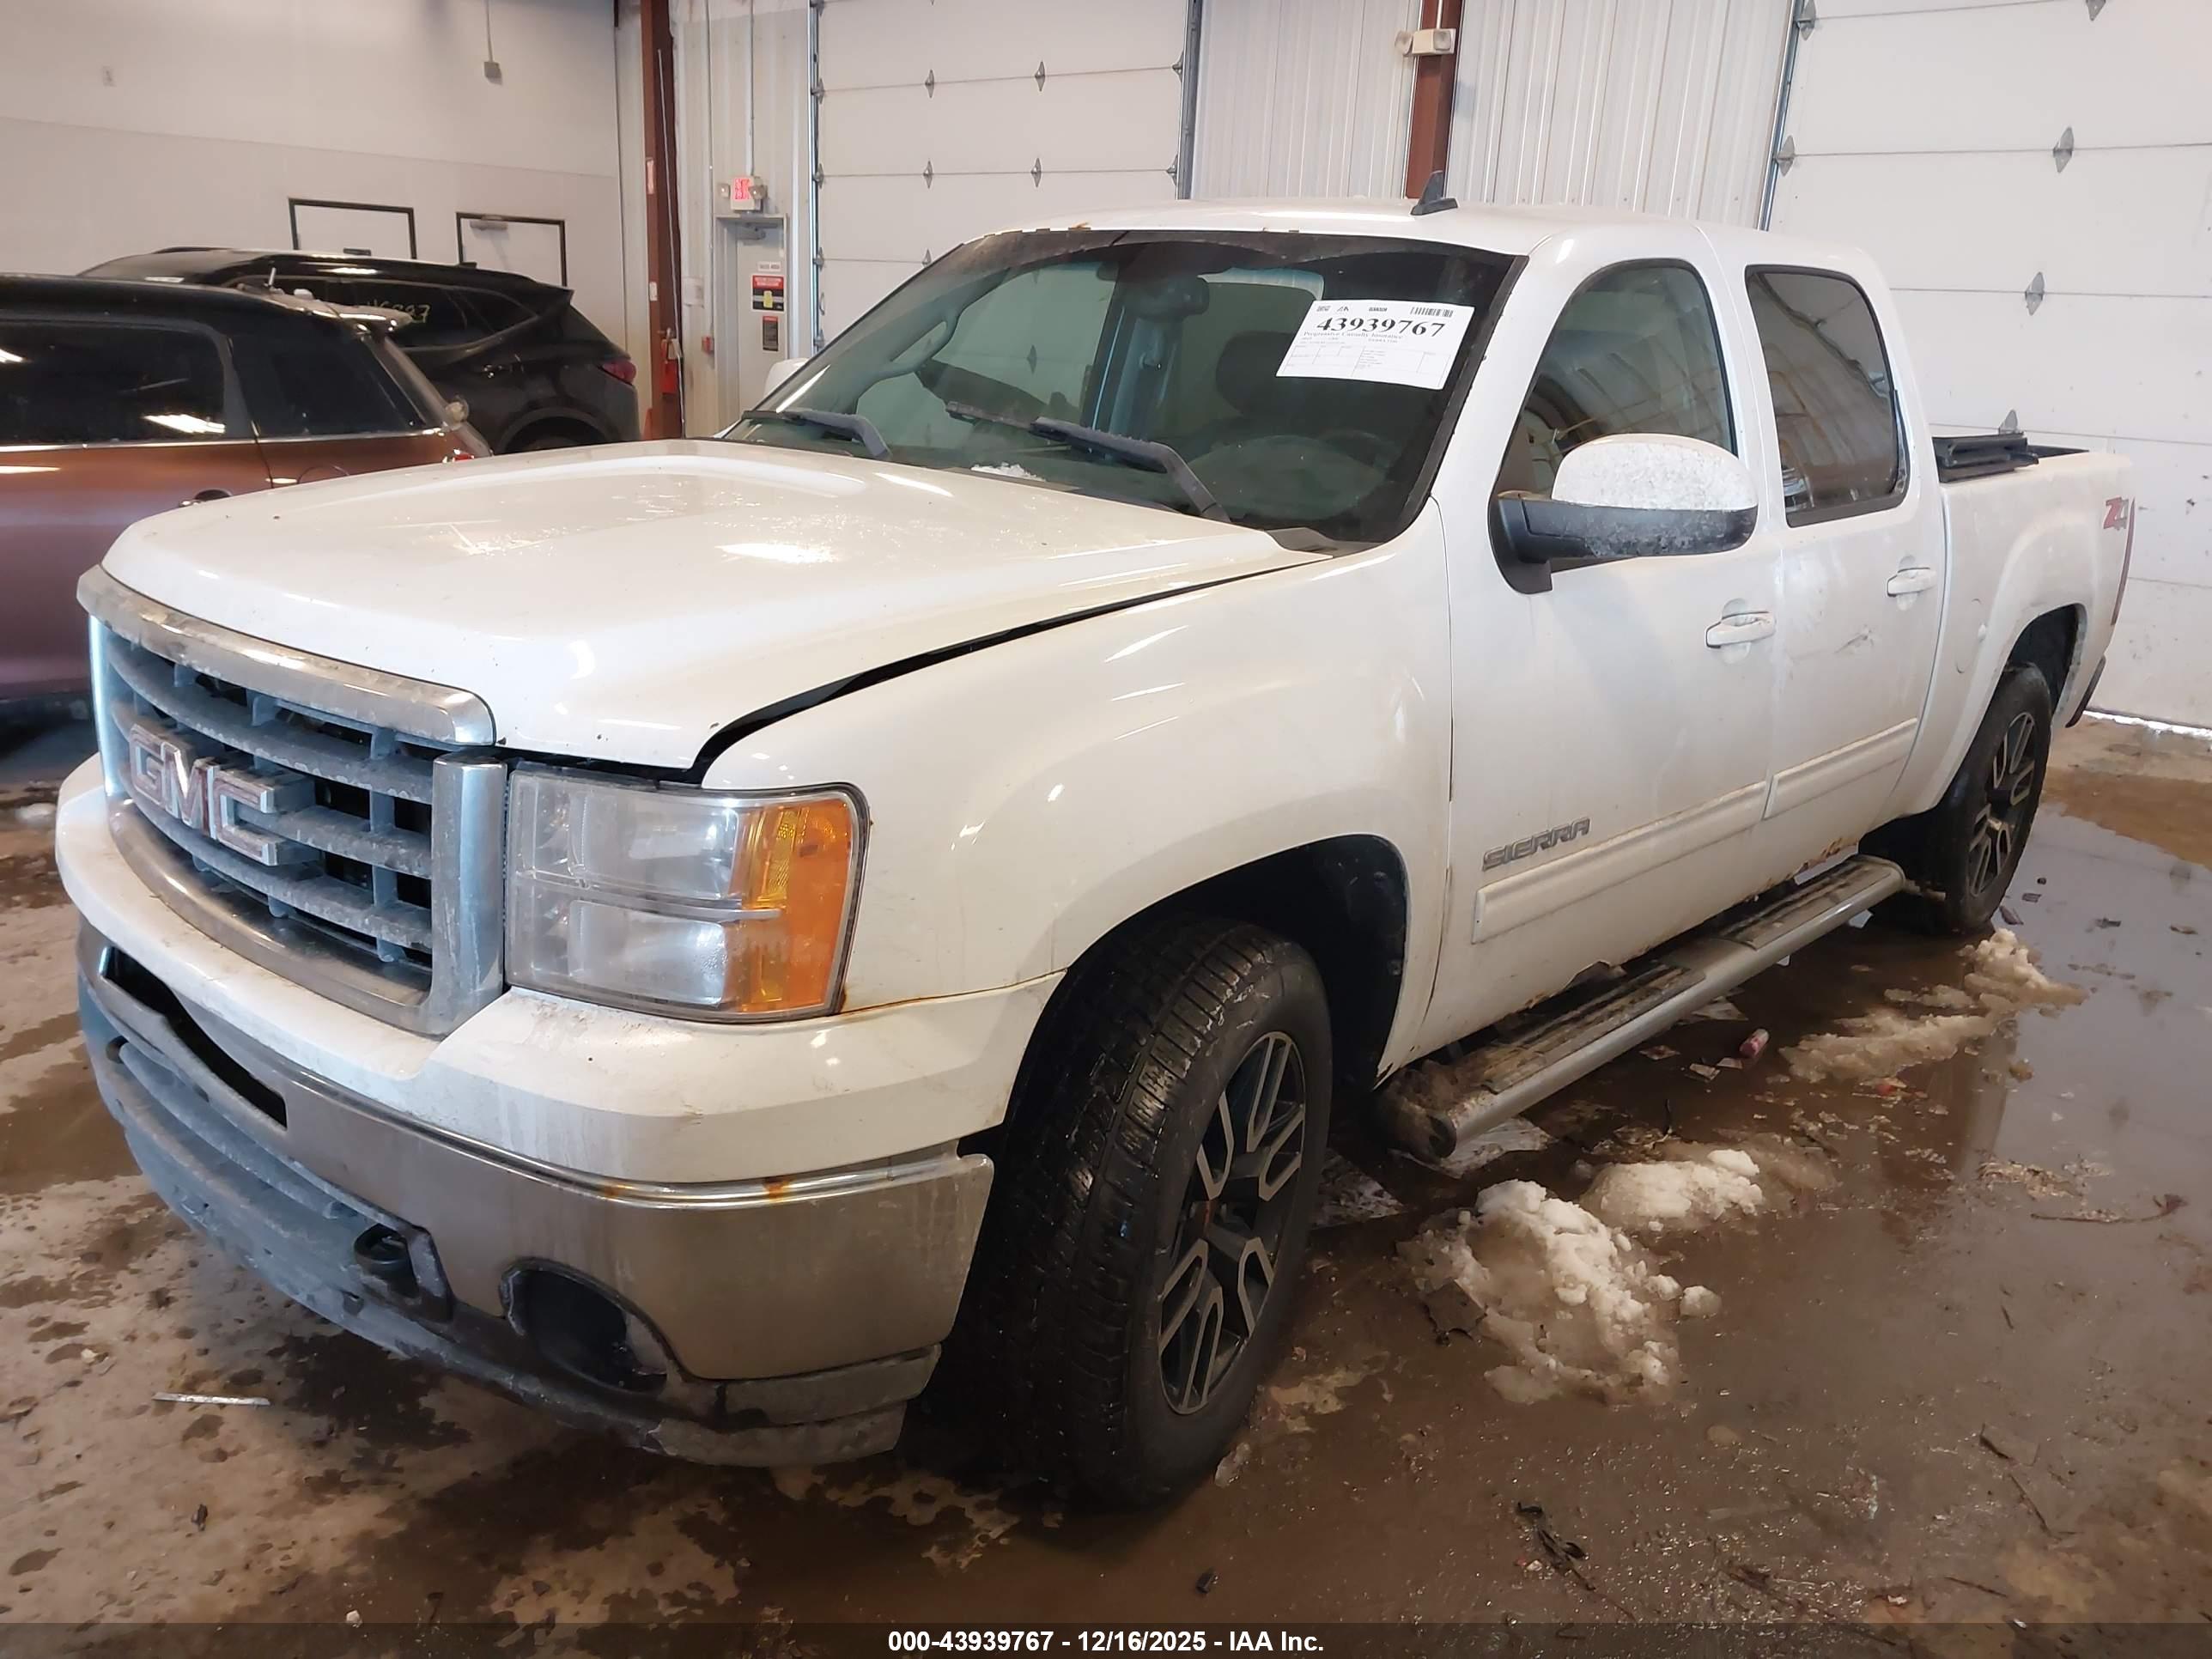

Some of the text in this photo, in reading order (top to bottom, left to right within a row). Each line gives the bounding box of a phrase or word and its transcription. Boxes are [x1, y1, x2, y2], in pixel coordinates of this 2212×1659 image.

[1316, 317, 1445, 337] 43939767
[130, 724, 278, 866] GMC
[1482, 817, 1590, 872] SIERRA
